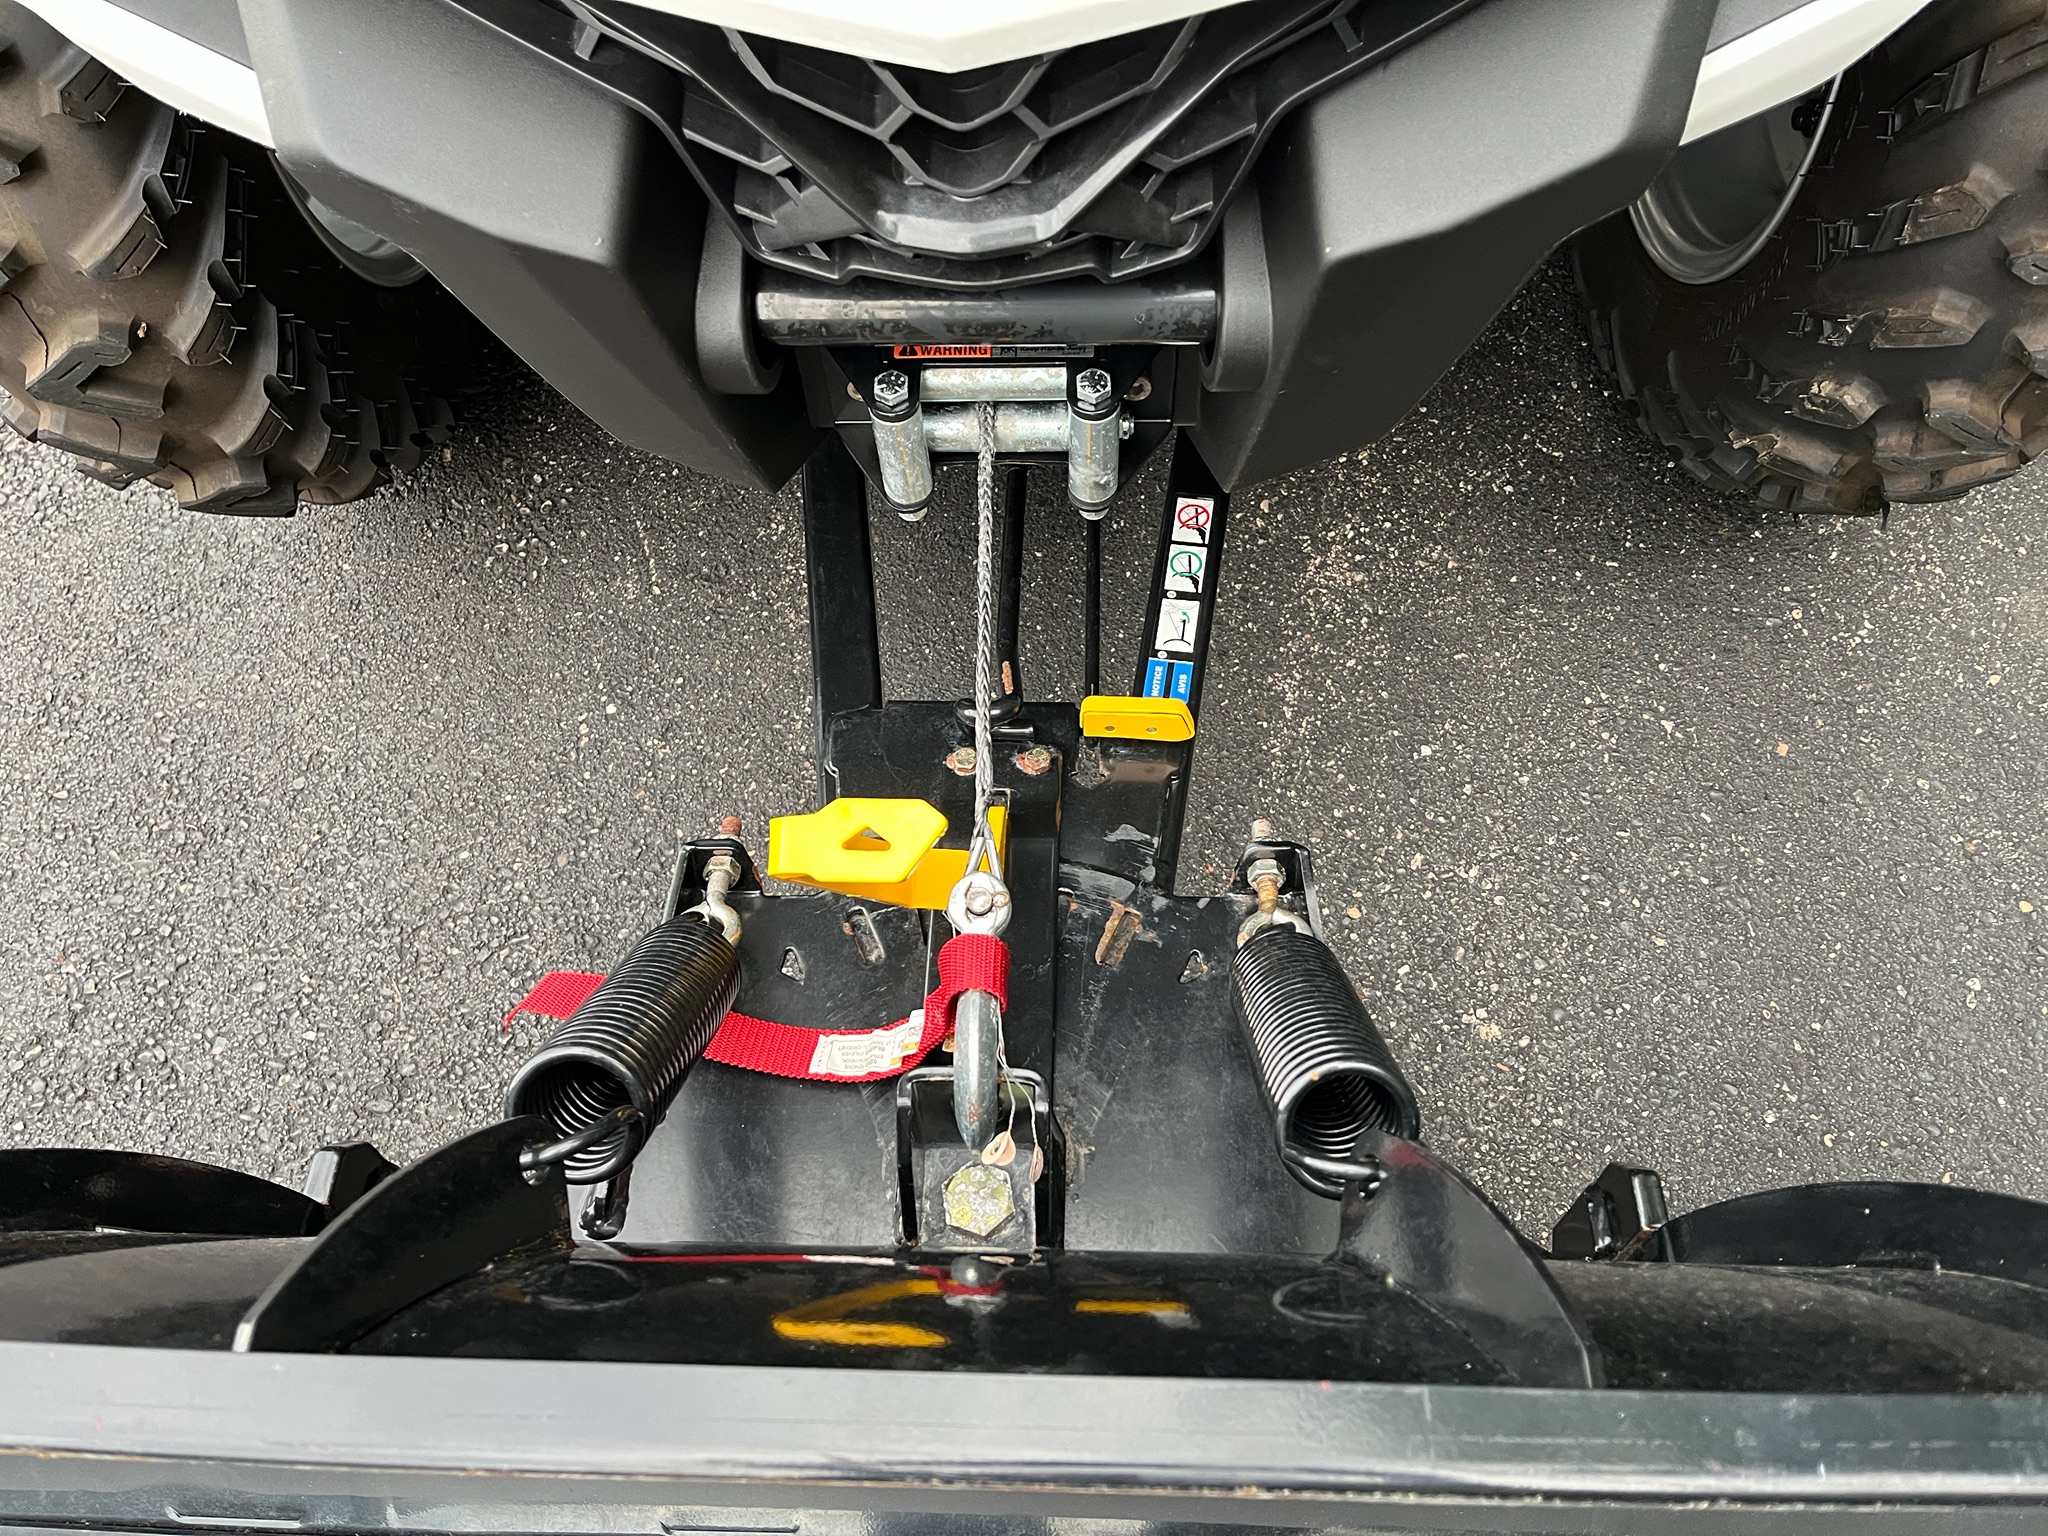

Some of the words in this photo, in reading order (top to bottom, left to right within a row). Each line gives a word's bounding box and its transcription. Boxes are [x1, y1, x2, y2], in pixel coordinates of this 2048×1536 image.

[919, 345, 988, 356] WARNING
[1151, 665, 1164, 697] NOTICE
[1177, 673, 1188, 695] AVIS
